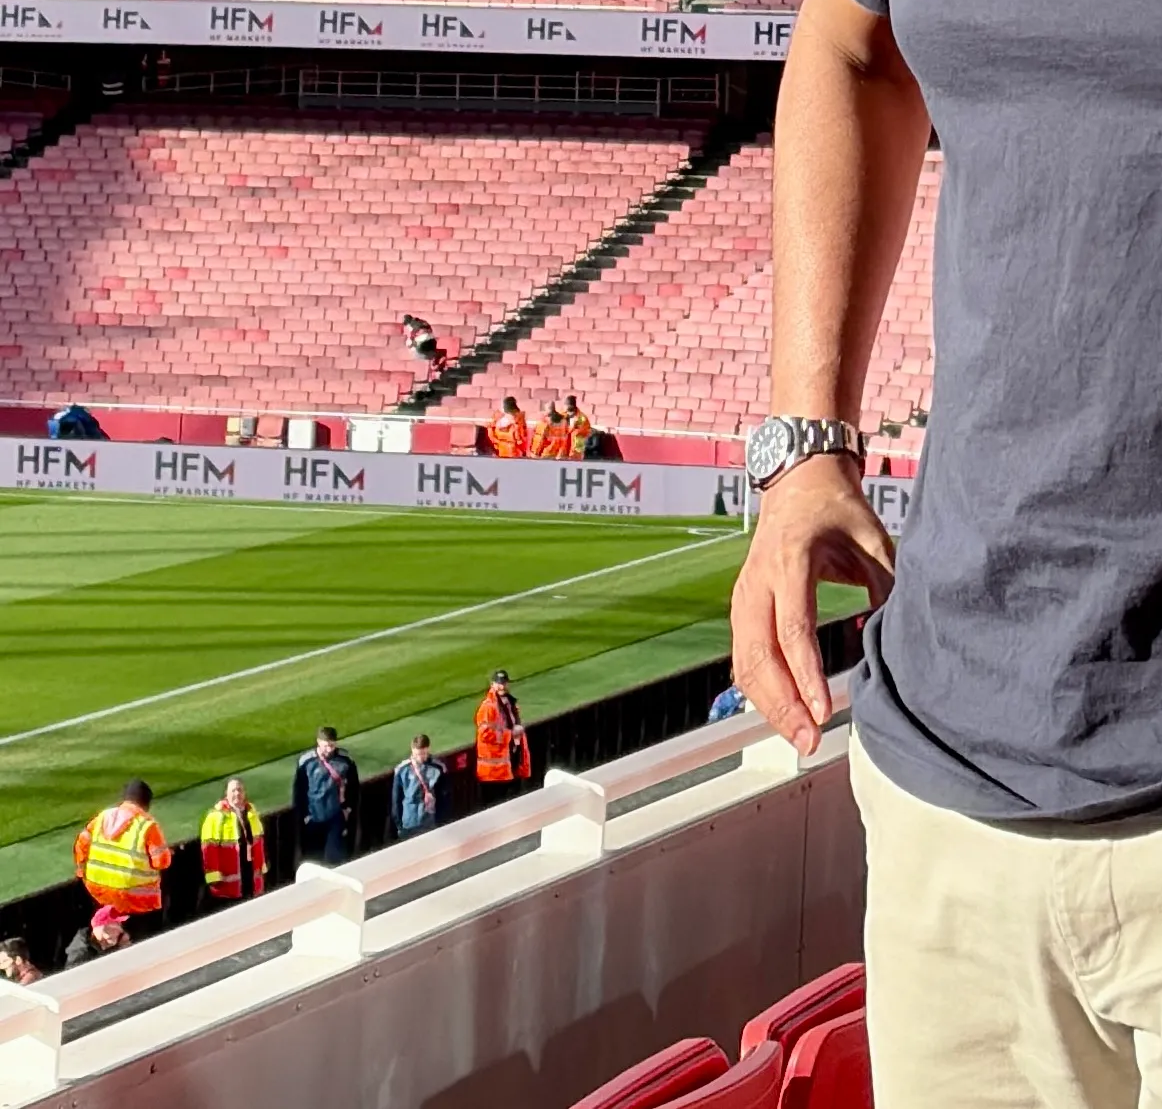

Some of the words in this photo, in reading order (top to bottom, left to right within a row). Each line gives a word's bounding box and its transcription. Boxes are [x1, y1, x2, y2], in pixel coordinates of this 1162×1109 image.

[210, 6, 273, 32] HFM
[319, 10, 383, 35] HFM
[641, 17, 706, 45] HFM
[17, 444, 97, 478] HFM
[155, 451, 235, 485] HFM
[284, 456, 365, 490] HFM
[16, 480, 31, 488] HF
[38, 480, 95, 491] MARKETS
[154, 486, 168, 494] HF
[176, 487, 235, 497] MARKETS
[418, 462, 498, 496] HFM
[559, 467, 641, 502] HFM
[283, 492, 298, 500] HF
[305, 493, 364, 503] MARKETS
[558, 503, 574, 511] HF
[581, 503, 641, 514] MARKETS
